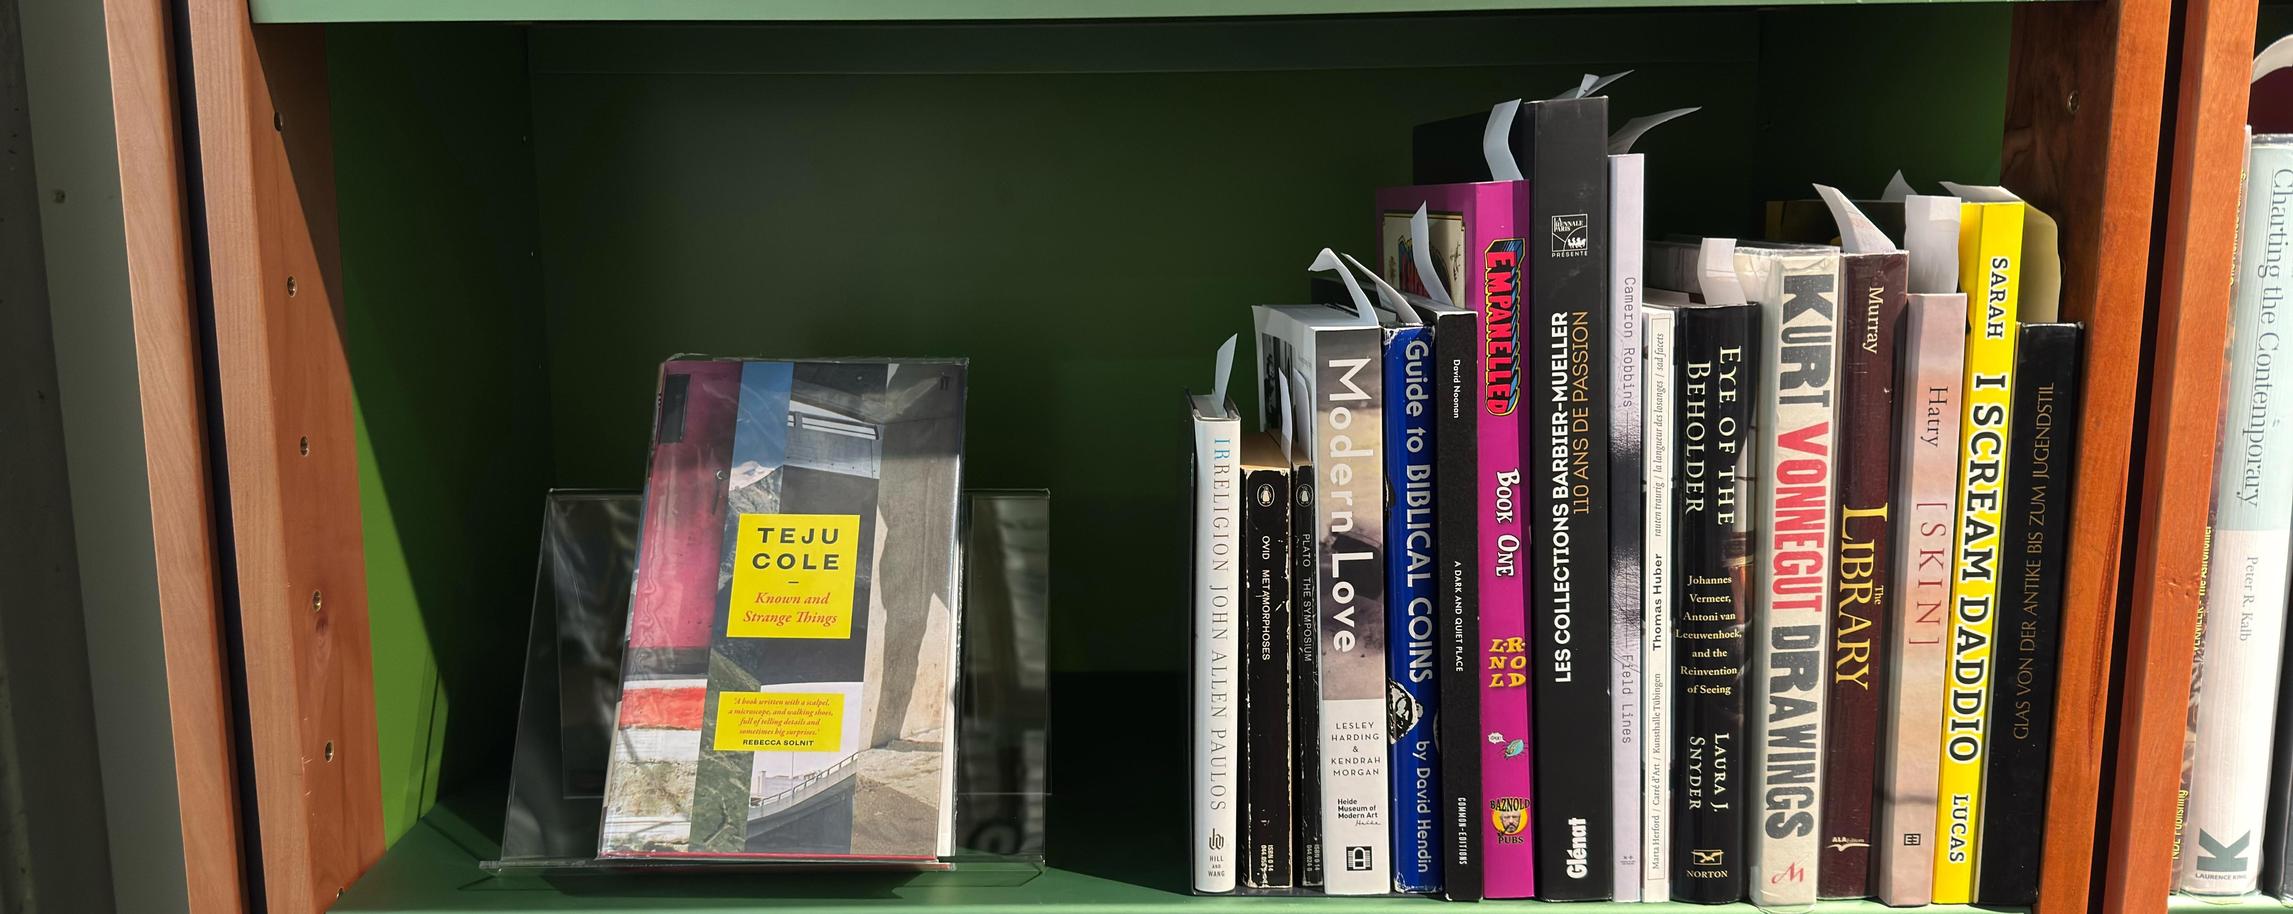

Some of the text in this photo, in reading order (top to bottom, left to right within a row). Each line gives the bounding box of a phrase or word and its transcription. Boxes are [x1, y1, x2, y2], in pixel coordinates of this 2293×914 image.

[1486, 248, 1520, 414] EMPANELLED
[1862, 285, 1885, 355] Murray
[1623, 276, 1636, 407] Cameron Robbins
[1655, 332, 1667, 357] facets
[2236, 168, 2293, 508] Charting the Contemporary
[1655, 357, 1664, 372] sad
[1453, 359, 1461, 419] David Noonan
[1654, 379, 1667, 415] losanges
[1572, 311, 1590, 515] 110 ANS DE PASSION
[1654, 415, 1663, 428] des
[1920, 386, 1949, 448] Hatry
[1653, 428, 1666, 464] langueur
[1685, 360, 1712, 515] BEHOLDER
[1718, 345, 1742, 526] EYE OF THE
[1653, 465, 1662, 473] la
[1328, 357, 1375, 653] Modern Love
[1551, 311, 1572, 683] LES COLLECTIONS BARBIER-MUELLER
[1655, 481, 1665, 515] traurig
[758, 528, 839, 544] TEJU
[1655, 516, 1663, 537] rauten
[752, 553, 839, 570] COLE
[1765, 273, 1835, 840] KURT VONNEGUT DRAWINGS
[1948, 257, 2009, 864] SARAH I SCREAM DADDIO LUCAS
[2014, 382, 2055, 741] GLAS VON DER ANTIKE BIS ZUM JUGENDSTIL
[1687, 575, 1732, 587] Johannes
[1836, 501, 1889, 691] LIBRARY
[1874, 584, 1885, 605] The
[755, 592, 831, 605] Known and
[1261, 535, 1271, 661] OVID METAMORPHOSES
[1302, 533, 1313, 662] PLATO THE SYMPOSIUM
[1405, 339, 1434, 873] Guide to BIBLICAL COINS by David Hendin
[1652, 553, 1663, 652] Thomas Huber
[1689, 593, 1732, 604] Vermeer,
[2239, 557, 2259, 642] Peter R. Kalb
[743, 611, 837, 627] Strange Things
[1209, 438, 1230, 811] IRRELIGION JOHN ALLEN PAULOS
[1454, 560, 1464, 672] A DARK AND QUIET PLACE
[1683, 611, 1737, 622] Antoni van
[1675, 628, 1743, 640] Leeuwenhoek,
[1691, 648, 1728, 658] and the
[1680, 664, 1738, 676] Reinvention
[742, 697, 757, 705] book
[1621, 654, 1634, 744] Field Lines
[1652, 673, 1664, 712] Tübingen
[1687, 684, 1732, 696] of Seeing
[734, 708, 770, 717] microscope,
[787, 708, 814, 718] walking
[815, 709, 834, 717] shoes,
[739, 718, 754, 727] full
[761, 718, 783, 727] telling
[784, 718, 806, 726] details
[807, 718, 821, 726] and
[1335, 721, 1375, 730] LESLEY
[775, 728, 785, 737] big
[1331, 732, 1380, 742] HARDING
[1652, 712, 1661, 754] Kunsthalle
[1331, 756, 1381, 765] KENDRAH
[1352, 745, 1359, 753] &
[1333, 768, 1380, 777] MORGAN
[1688, 735, 1706, 810] SNYDER
[1713, 732, 1730, 813] LAURA J.
[1369, 804, 1376, 812] of
[1490, 797, 1530, 812] BAZNOLD
[1652, 784, 1660, 806] Carré
[1457, 797, 1468, 865] COMMON-EDITIONS
[1498, 835, 1524, 844] PUBS
[1652, 815, 1660, 846] Herford
[1566, 817, 1588, 880] Glénat
[1652, 846, 1660, 870] Marta
[2196, 827, 2252, 872] K
[1686, 869, 1729, 879] NORTON
[2195, 873, 2232, 881] LAURENCE
